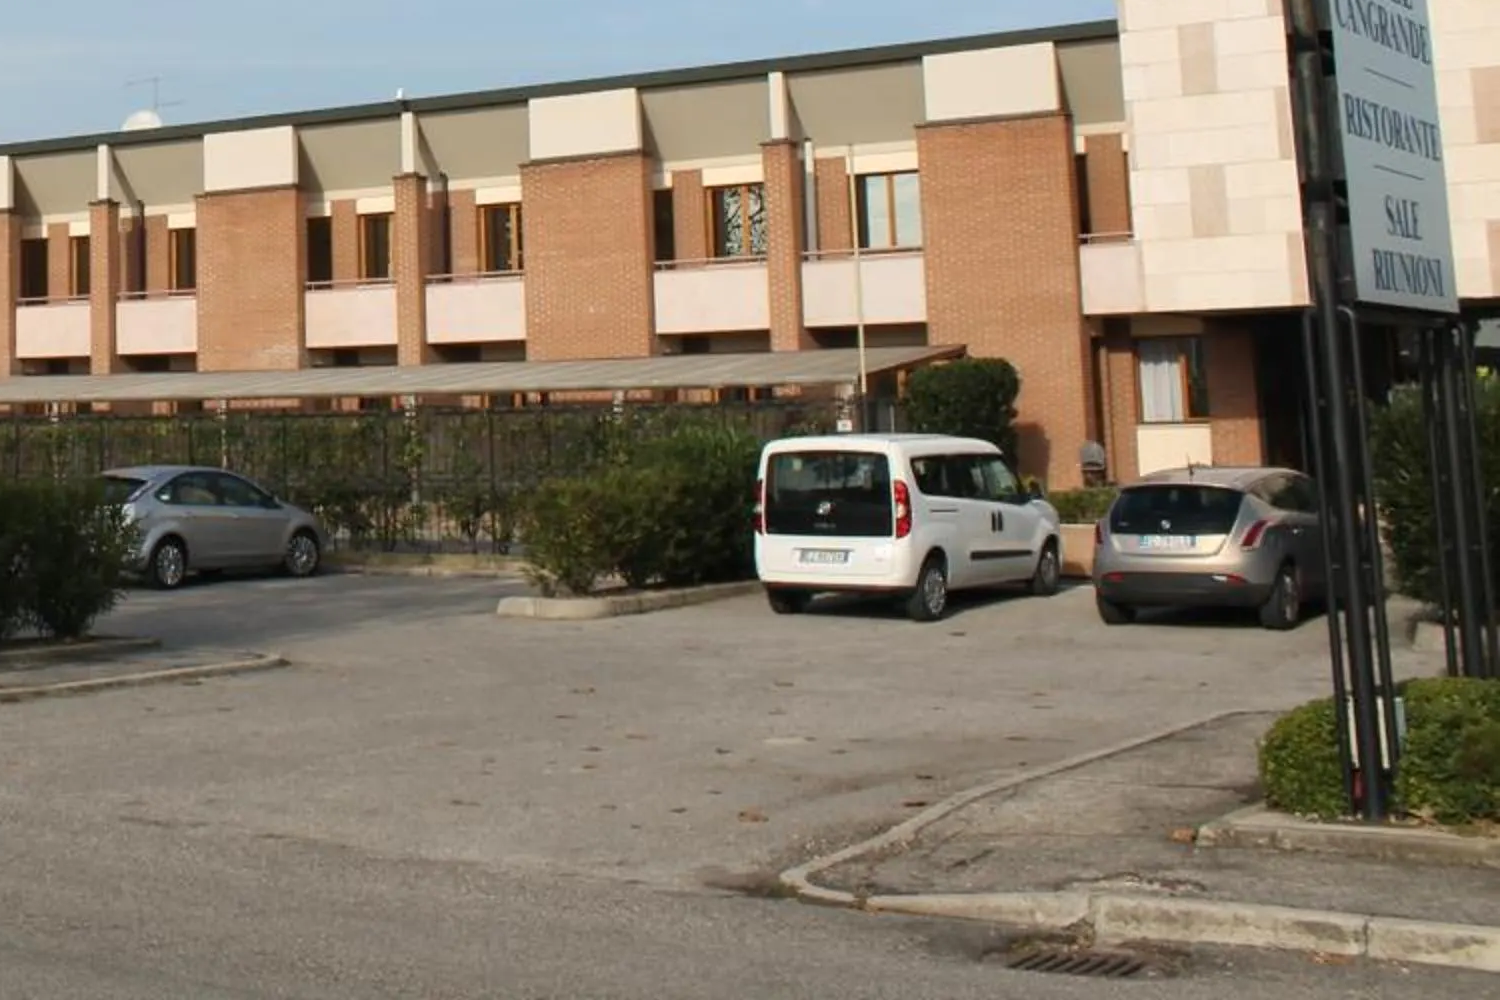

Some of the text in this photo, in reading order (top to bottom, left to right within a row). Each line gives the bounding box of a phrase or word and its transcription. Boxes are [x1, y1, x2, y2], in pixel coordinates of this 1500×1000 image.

[1343, 92, 1441, 162] RISTORANTE
[1384, 193, 1423, 241] SALE
[1371, 247, 1445, 297] RIUNIONI
